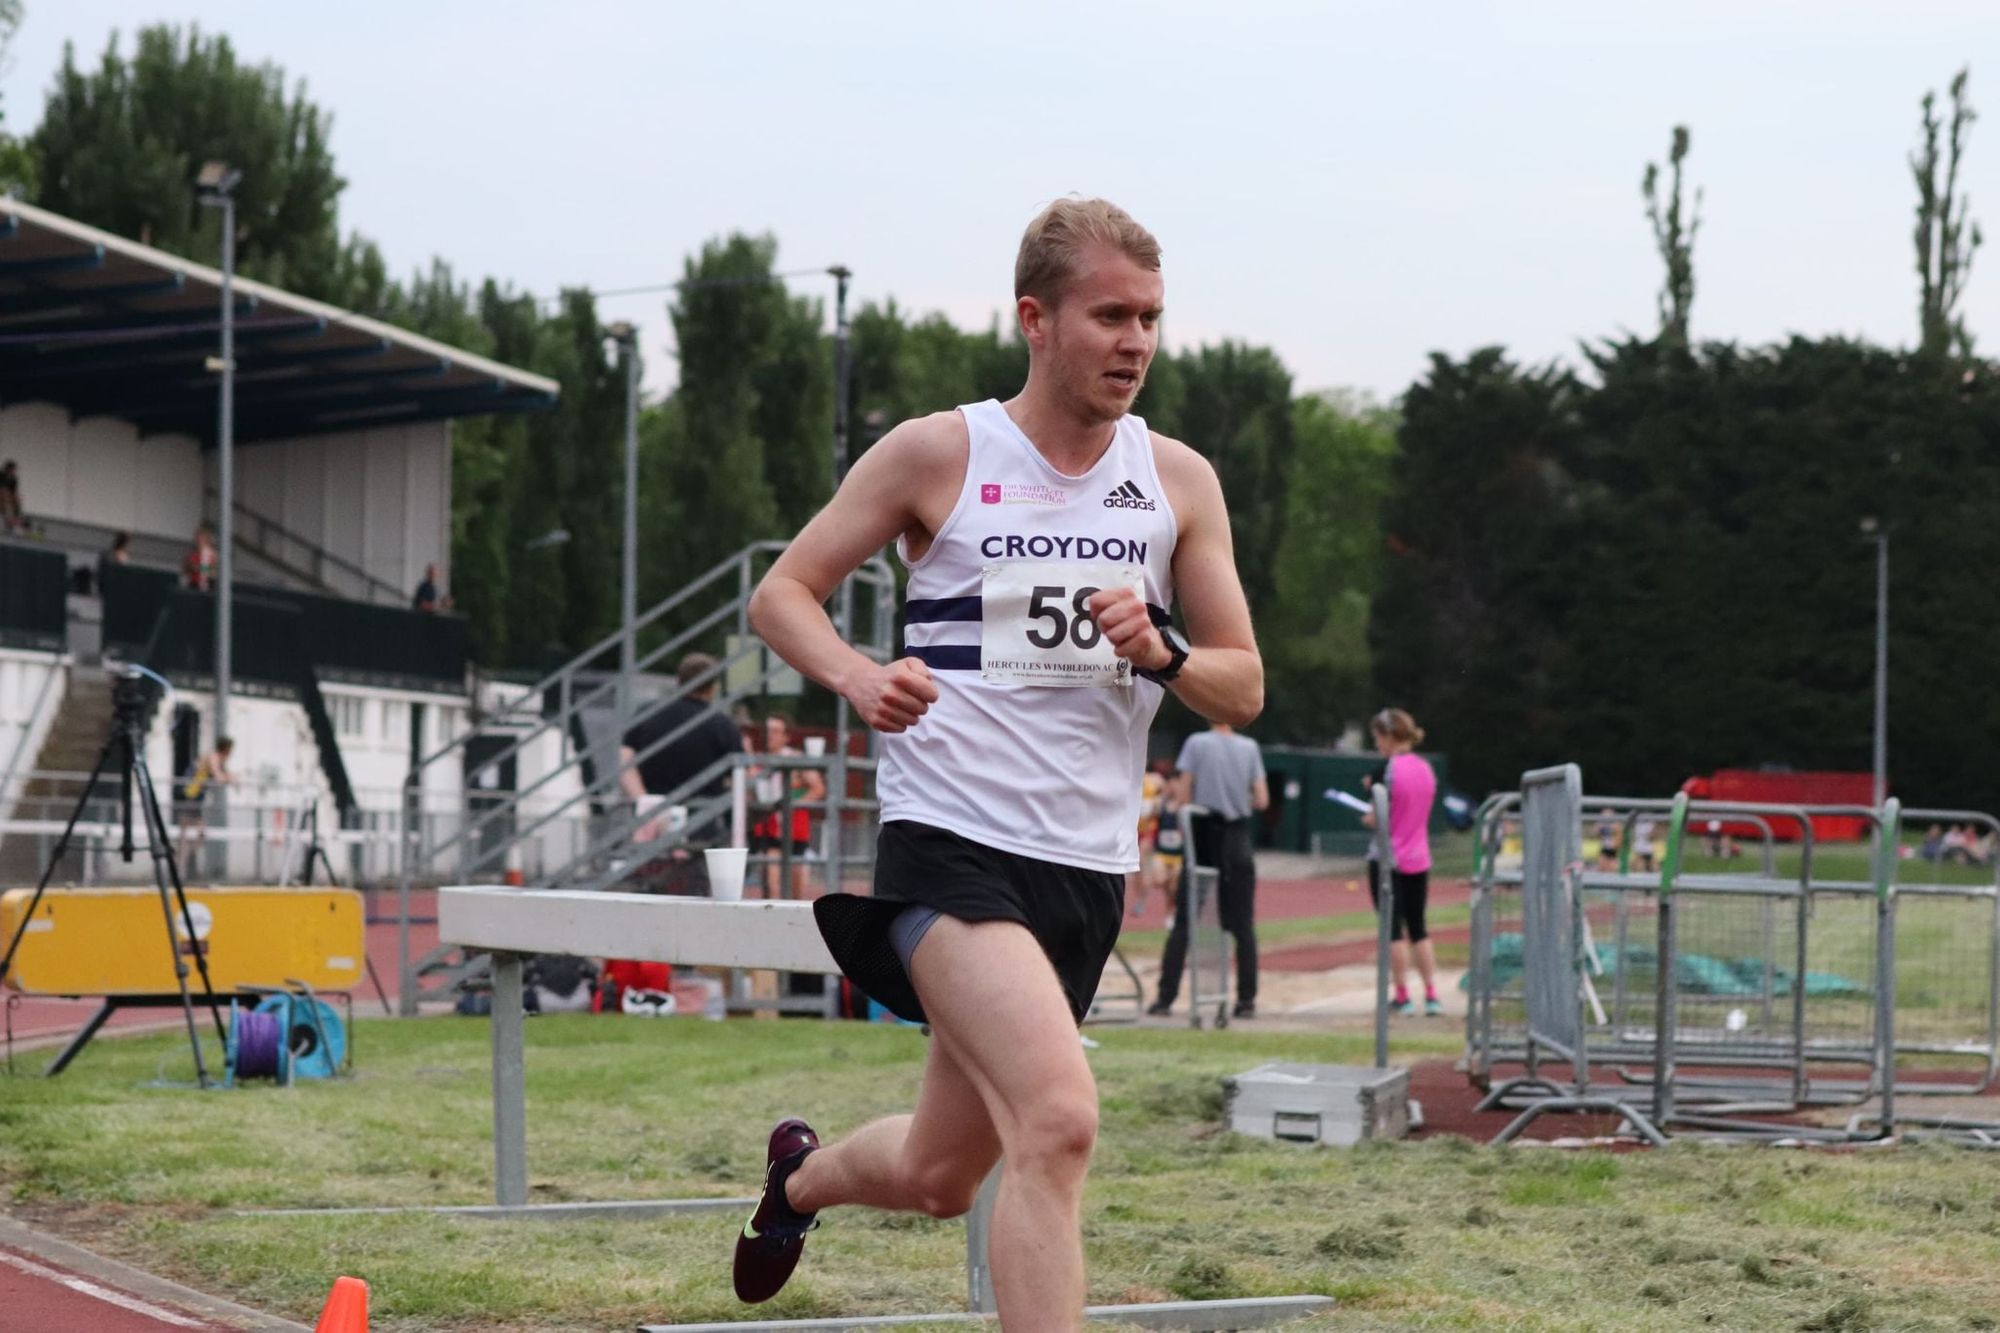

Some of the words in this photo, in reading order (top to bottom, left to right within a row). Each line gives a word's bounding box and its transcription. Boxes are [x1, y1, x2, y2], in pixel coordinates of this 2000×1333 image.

[1103, 496, 1156, 511] adidas
[980, 535, 1147, 565] CROYDON
[1026, 586, 1103, 650] 58
[987, 660, 1041, 671] HERCULES
[1043, 662, 1101, 673] WIMBLEDON
[1101, 664, 1114, 672] AC
